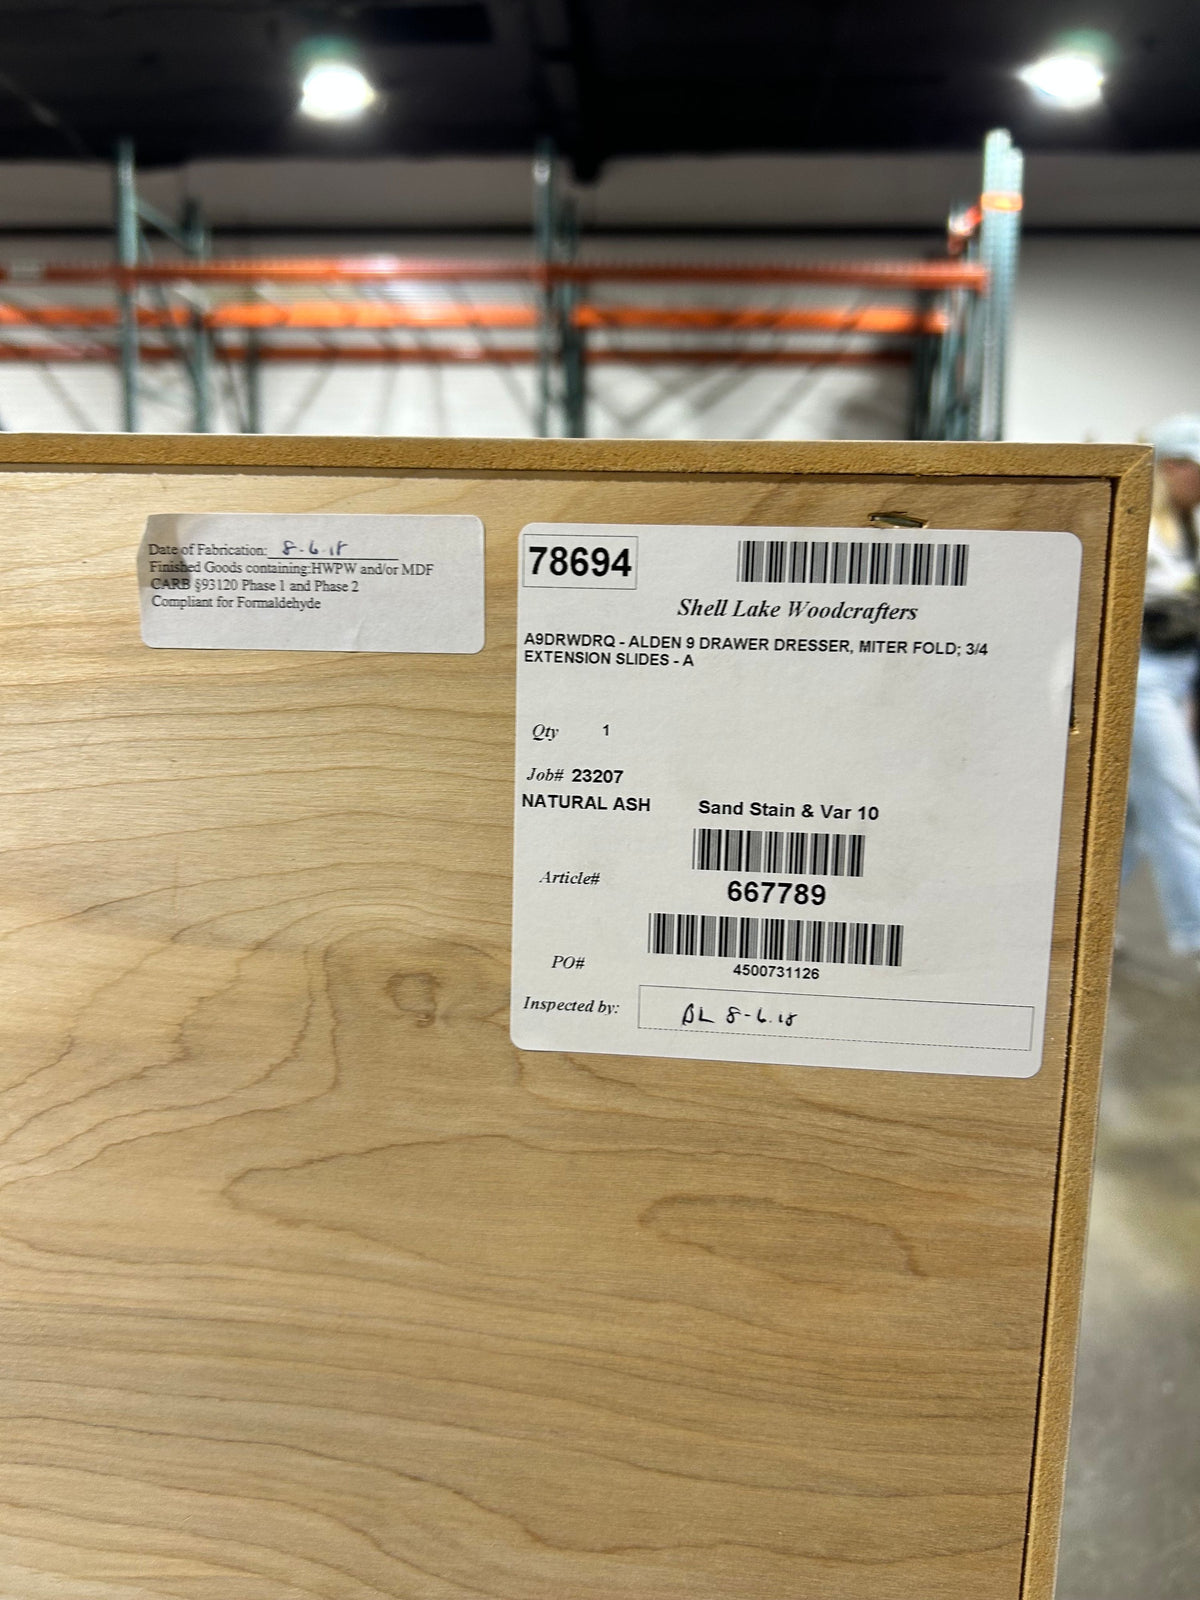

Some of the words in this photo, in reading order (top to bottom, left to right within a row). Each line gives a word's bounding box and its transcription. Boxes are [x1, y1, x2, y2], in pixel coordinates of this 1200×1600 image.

[147, 543, 179, 556] Date
[180, 542, 196, 556] of
[196, 543, 268, 556] Fabrication:
[148, 560, 202, 573] Finished
[203, 560, 243, 574] Goods
[359, 562, 399, 576] and/or
[401, 563, 435, 576] MDF
[528, 546, 633, 578] 78694
[150, 578, 191, 590] CARB
[195, 578, 239, 593] §93120
[241, 578, 277, 592] Phase
[279, 579, 286, 592] 1
[289, 579, 312, 592] and
[314, 579, 349, 593] Phase
[351, 580, 360, 593] 2
[151, 594, 214, 611] Compliant
[216, 596, 235, 608] for
[236, 596, 322, 612] Formaldehyde
[677, 598, 729, 617] Shell
[732, 599, 782, 618] Lake
[788, 600, 919, 625] Woodcrafters
[523, 632, 616, 649] A9DRWDRQ
[628, 635, 682, 649] ALDEN
[686, 636, 695, 649] 9
[699, 636, 769, 651] DRAWER
[774, 638, 854, 655] DRESSER,
[858, 640, 908, 654] MITER
[912, 641, 962, 657] FOLD;
[965, 642, 989, 656] 3/4
[524, 650, 612, 665] EXTENSION
[615, 652, 670, 666] SLIDES
[682, 653, 695, 667] A
[532, 723, 560, 742] Qty
[602, 724, 610, 737] 1
[526, 767, 565, 782] Job#
[571, 768, 624, 784] 23207
[521, 793, 608, 811] NATURAL
[612, 796, 651, 812] ASH
[697, 799, 744, 816] Sand
[749, 801, 796, 818] Stain
[800, 803, 815, 818] &
[819, 804, 852, 820] Var
[857, 805, 880, 821] 10
[538, 870, 601, 886] Article#
[727, 880, 826, 906] 667789
[551, 955, 585, 970] PO#
[732, 963, 820, 980] 4500731126
[523, 995, 595, 1013] Inspected
[597, 999, 620, 1016] by:
